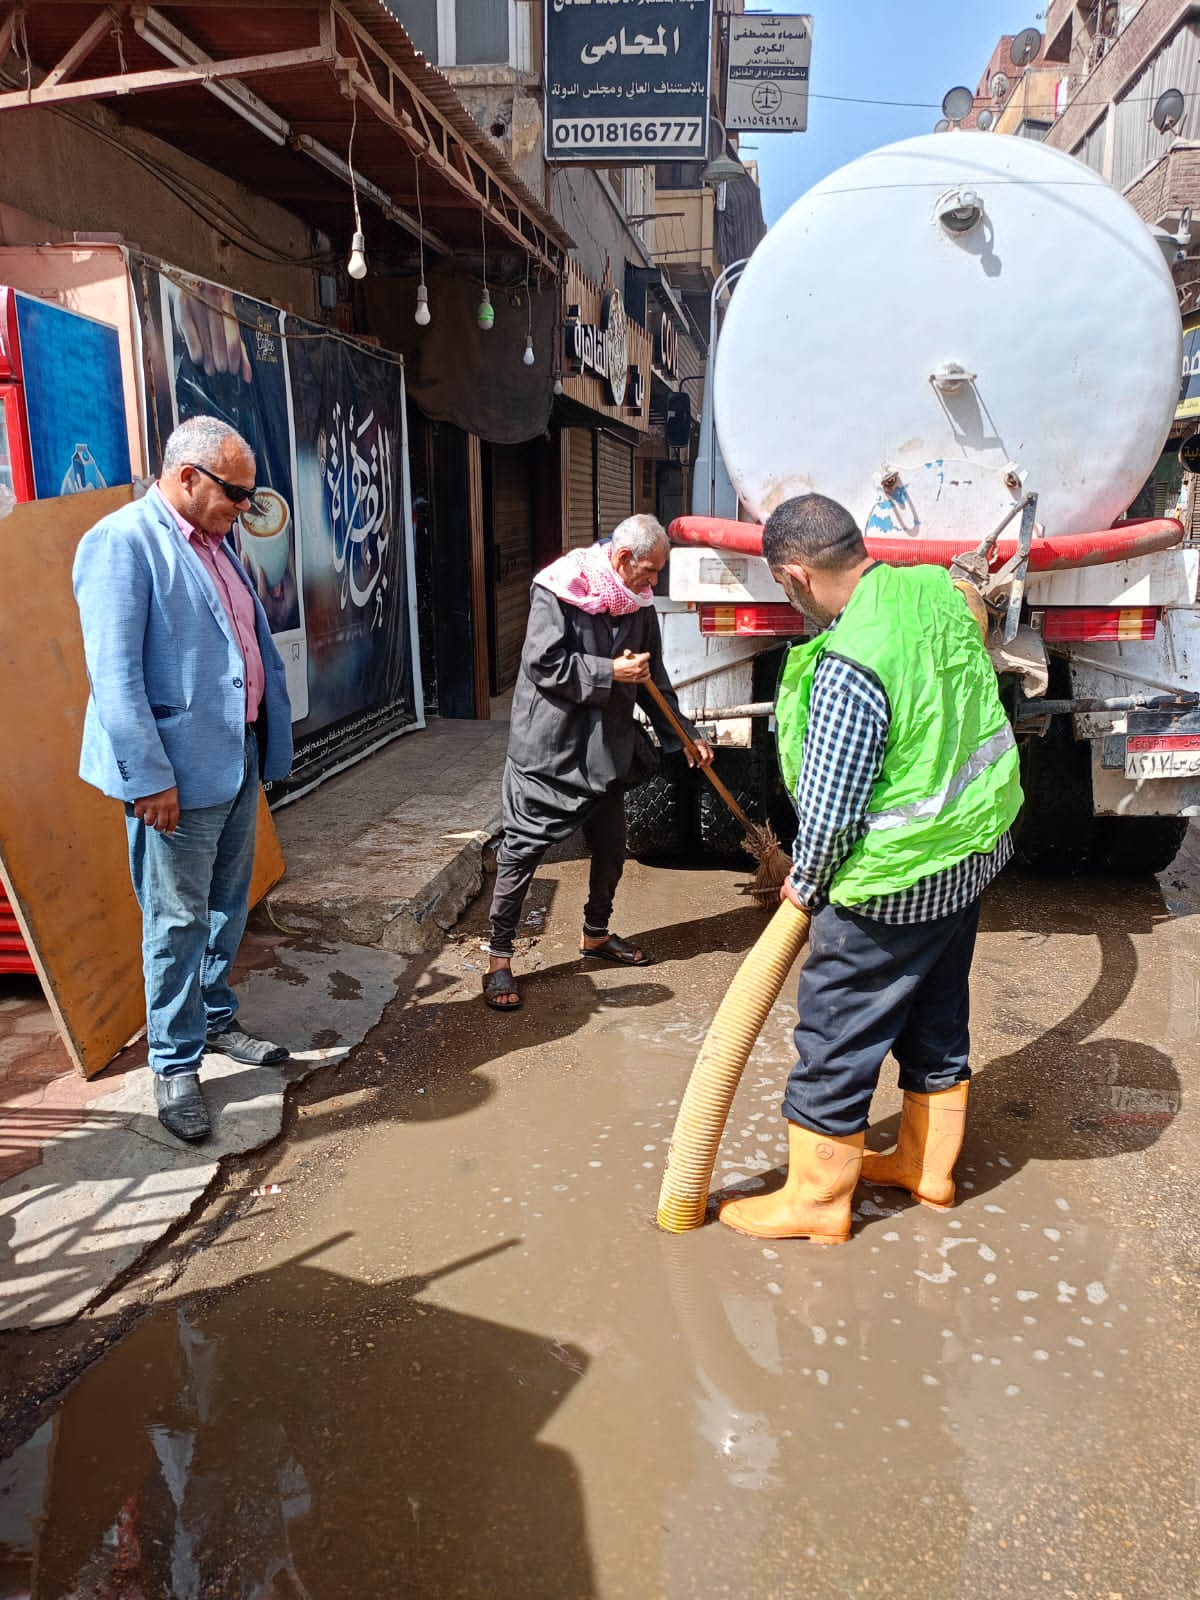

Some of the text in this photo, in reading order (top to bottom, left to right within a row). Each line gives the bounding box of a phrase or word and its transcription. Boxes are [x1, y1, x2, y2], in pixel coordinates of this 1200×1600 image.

[580, 23, 680, 65] المحامى
[551, 82, 579, 99] الدولة
[554, 121, 700, 144] 01018166777
